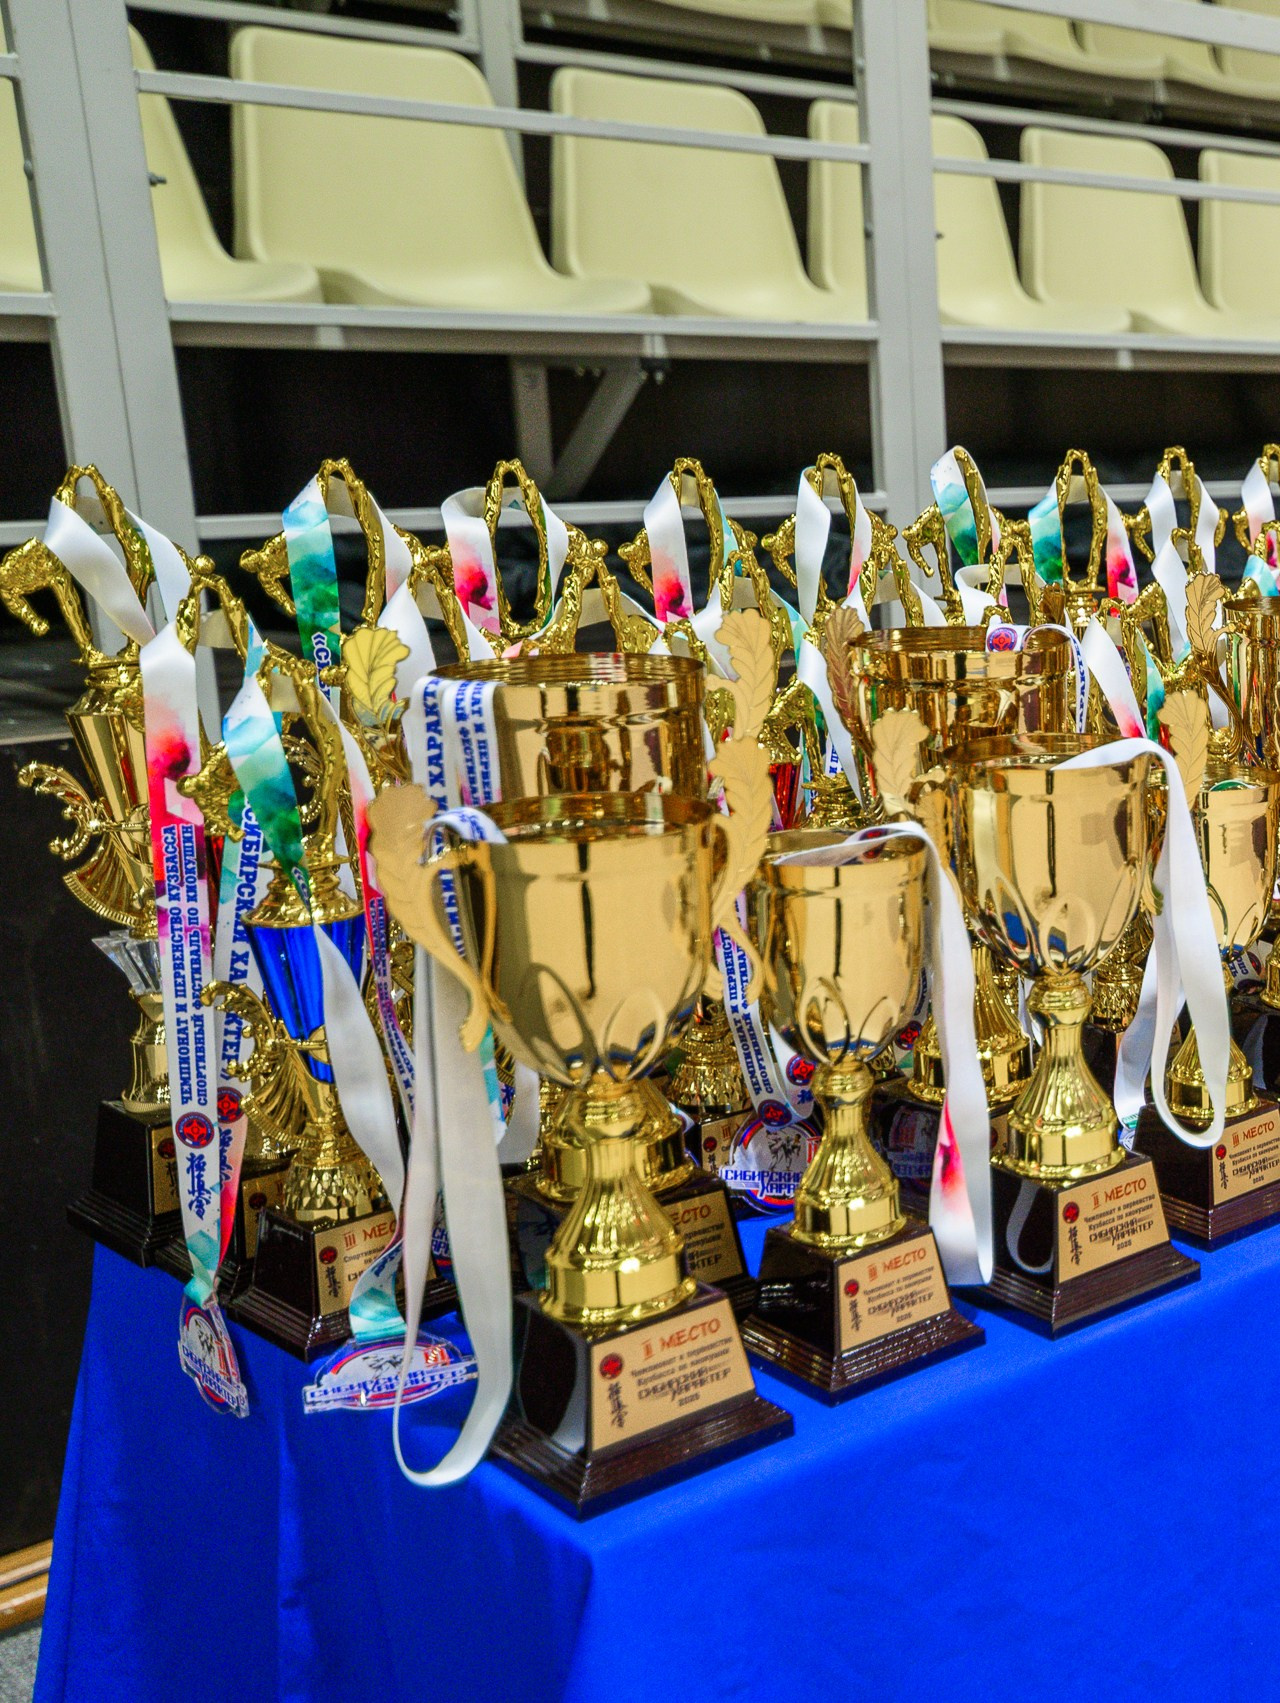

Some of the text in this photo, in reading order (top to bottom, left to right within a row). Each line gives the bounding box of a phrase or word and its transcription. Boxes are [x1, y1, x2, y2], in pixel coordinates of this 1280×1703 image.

[162, 825, 192, 1105] ЧЕМПИОНАТ И ПЕРВЕНСТВО КУЗБАССА
[182, 824, 208, 1106] СПОРТИВНЫЙ ФЕСТИВАЛЬ ПО КИОКУШИН
[731, 1005, 739, 1014] И
[734, 1018, 762, 1096] ЧЕМПИОНАТ
[1242, 1122, 1274, 1141] МЕСТО
[1104, 1178, 1147, 1203] МЕСТО
[670, 1204, 712, 1226] ЕСТО
[1084, 1208, 1115, 1225] Чемпионат
[1122, 1194, 1155, 1210] первенство
[1088, 1217, 1114, 1232] Кузбасса
[1090, 1219, 1136, 1242] СИБИРСКИЙ
[1111, 1221, 1153, 1245] ХАРАКТЕР
[883, 1249, 926, 1273] МЕСТО
[660, 1319, 721, 1351] МЕСТО
